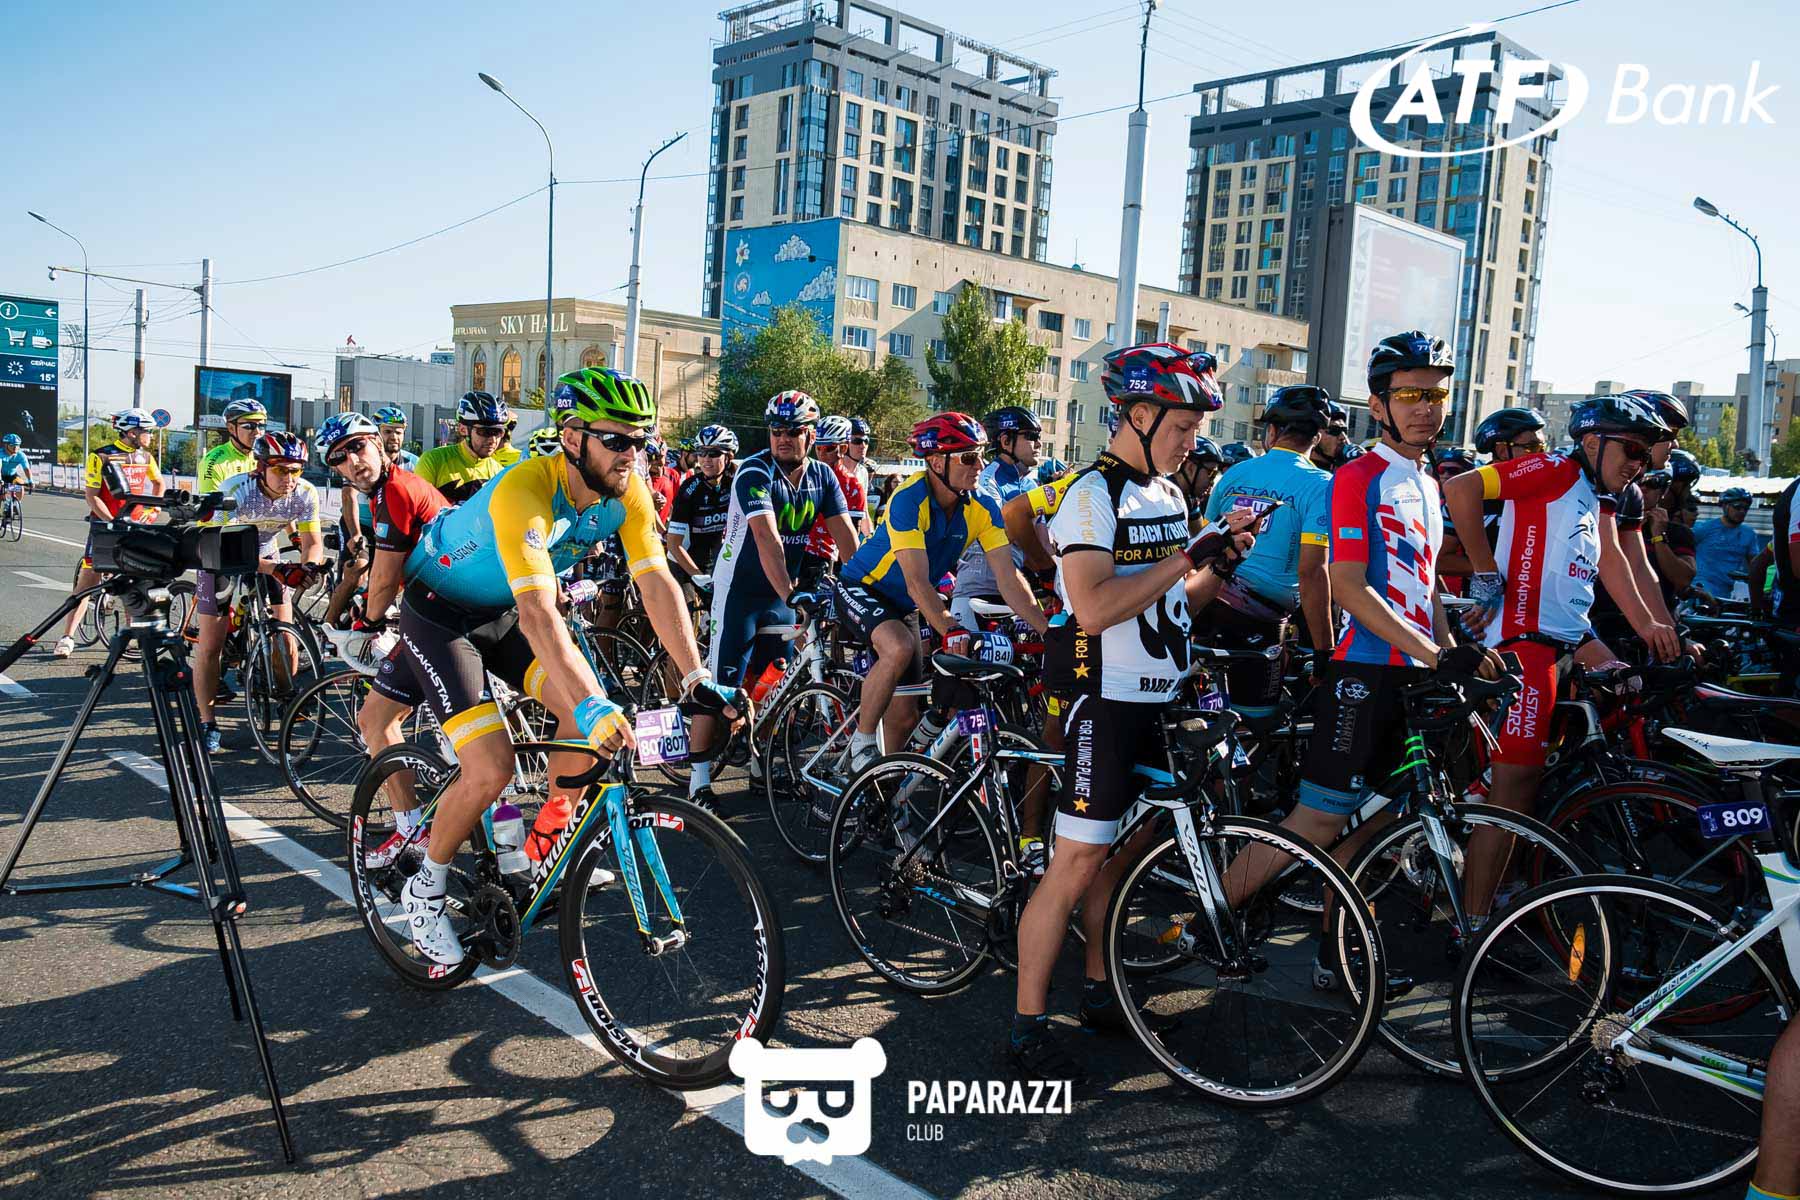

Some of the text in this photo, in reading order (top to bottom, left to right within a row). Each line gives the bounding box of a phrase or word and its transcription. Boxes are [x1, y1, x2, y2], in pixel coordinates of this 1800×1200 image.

[500, 315, 526, 335] SKY
[530, 312, 568, 334] HALL
[1129, 379, 1147, 390] 752
[557, 399, 573, 408] 807
[1580, 419, 1595, 428] 266
[328, 430, 340, 441] 829
[921, 440, 933, 449] 841
[1509, 461, 1544, 479] MOTORS
[1223, 486, 1297, 512] ASTANA
[729, 511, 740, 544] movistar
[780, 535, 811, 545] ovista
[449, 540, 478, 561] ASTANA
[1115, 544, 1180, 561] FOR A LIVIN
[995, 650, 1011, 661] 841
[1075, 640, 1089, 659] FOR
[402, 633, 453, 714] KAZAKHSTAN
[757, 652, 802, 719] COLNAGO
[1139, 677, 1175, 694] RIDE
[1209, 697, 1223, 710] 770
[1523, 686, 1540, 739] ASTANA
[1079, 720, 1092, 734] FOR
[666, 736, 684, 752] 807
[1077, 742, 1092, 766] LIVING
[1075, 767, 1091, 797] PLANET
[1722, 807, 1763, 828] 809
